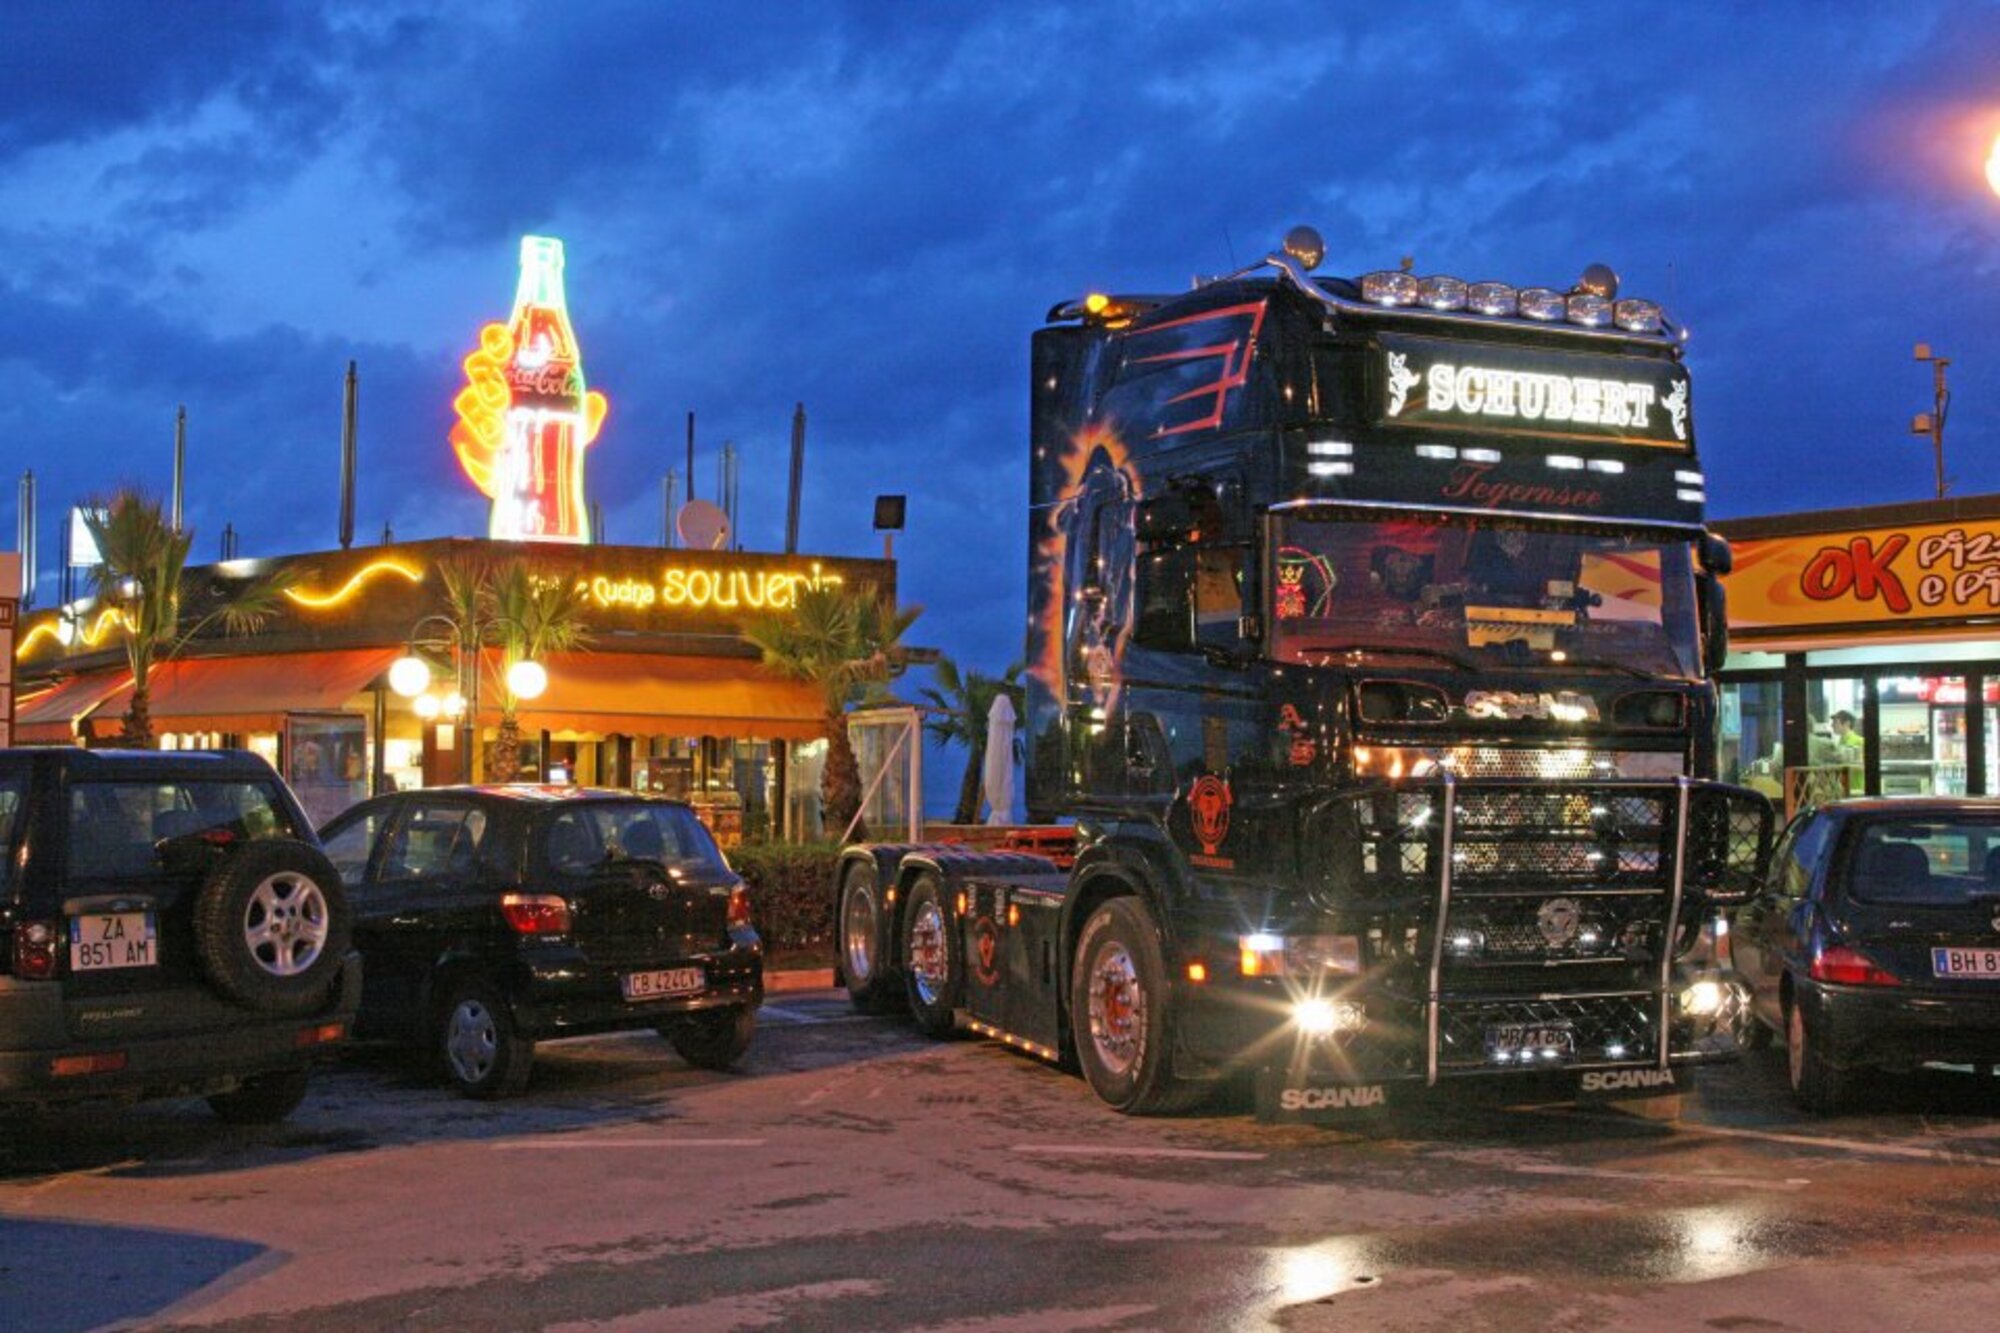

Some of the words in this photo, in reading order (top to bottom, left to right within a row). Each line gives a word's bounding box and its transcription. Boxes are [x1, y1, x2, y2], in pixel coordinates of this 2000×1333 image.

[1427, 364, 1655, 428] SCHUBERT
[1441, 463, 1602, 508] Tegernsee
[1801, 533, 1913, 614] OK
[101, 917, 125, 940] ZA
[80, 942, 114, 966] 851
[126, 941, 150, 963] AM
[1950, 951, 1978, 972] BH
[1984, 952, 2000, 972] 8
[1580, 1068, 1675, 1091] SCANIA
[1280, 1085, 1386, 1111] SCANIA
